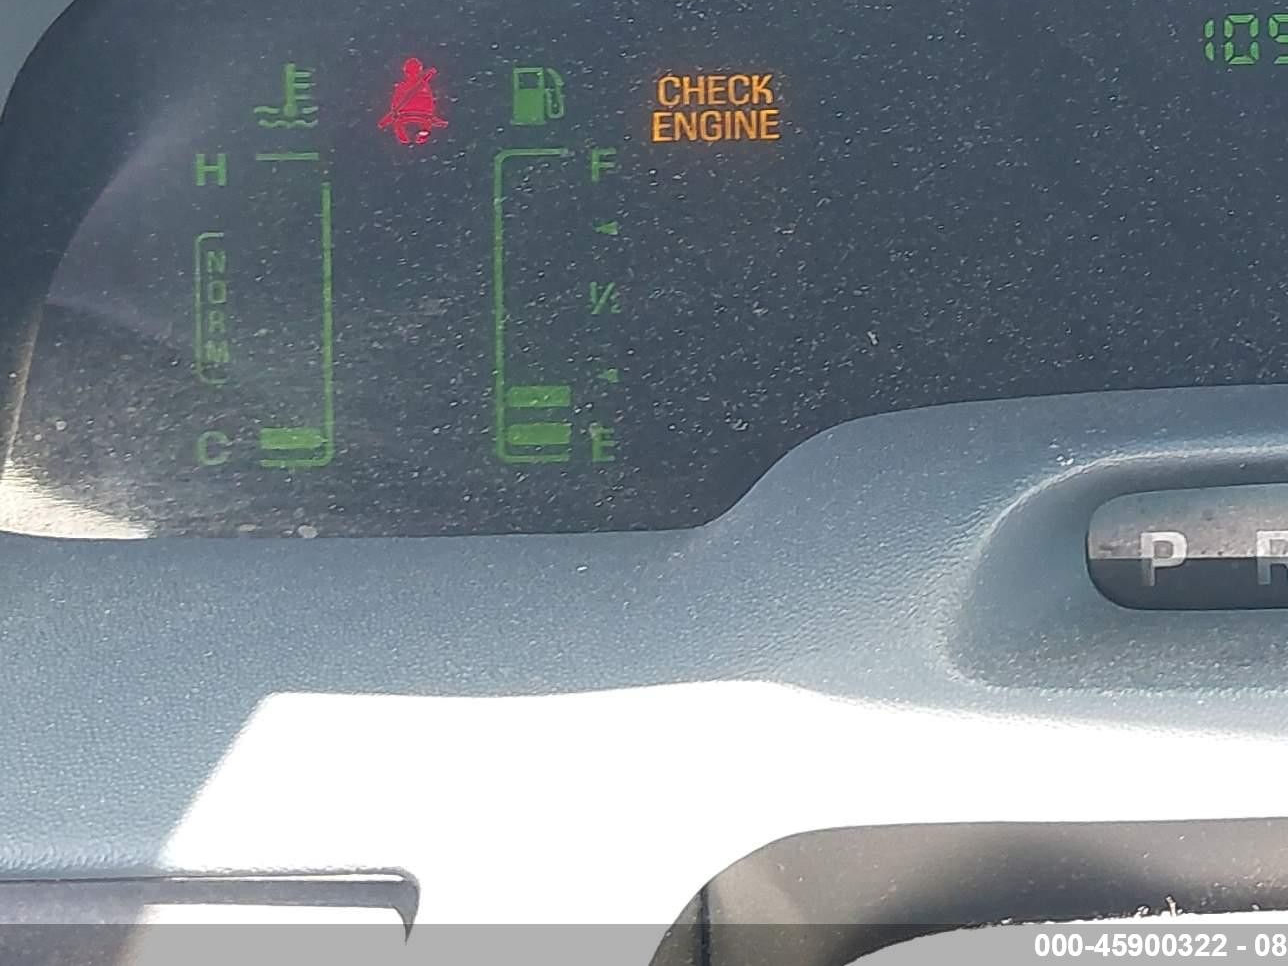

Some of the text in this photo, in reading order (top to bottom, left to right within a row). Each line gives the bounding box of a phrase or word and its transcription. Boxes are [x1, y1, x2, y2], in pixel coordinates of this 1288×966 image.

[656, 74, 774, 106] CHECK
[651, 109, 780, 142] ENGINE
[195, 152, 227, 186] H
[590, 147, 617, 180] F
[198, 432, 230, 466] C
[591, 427, 616, 461] E
